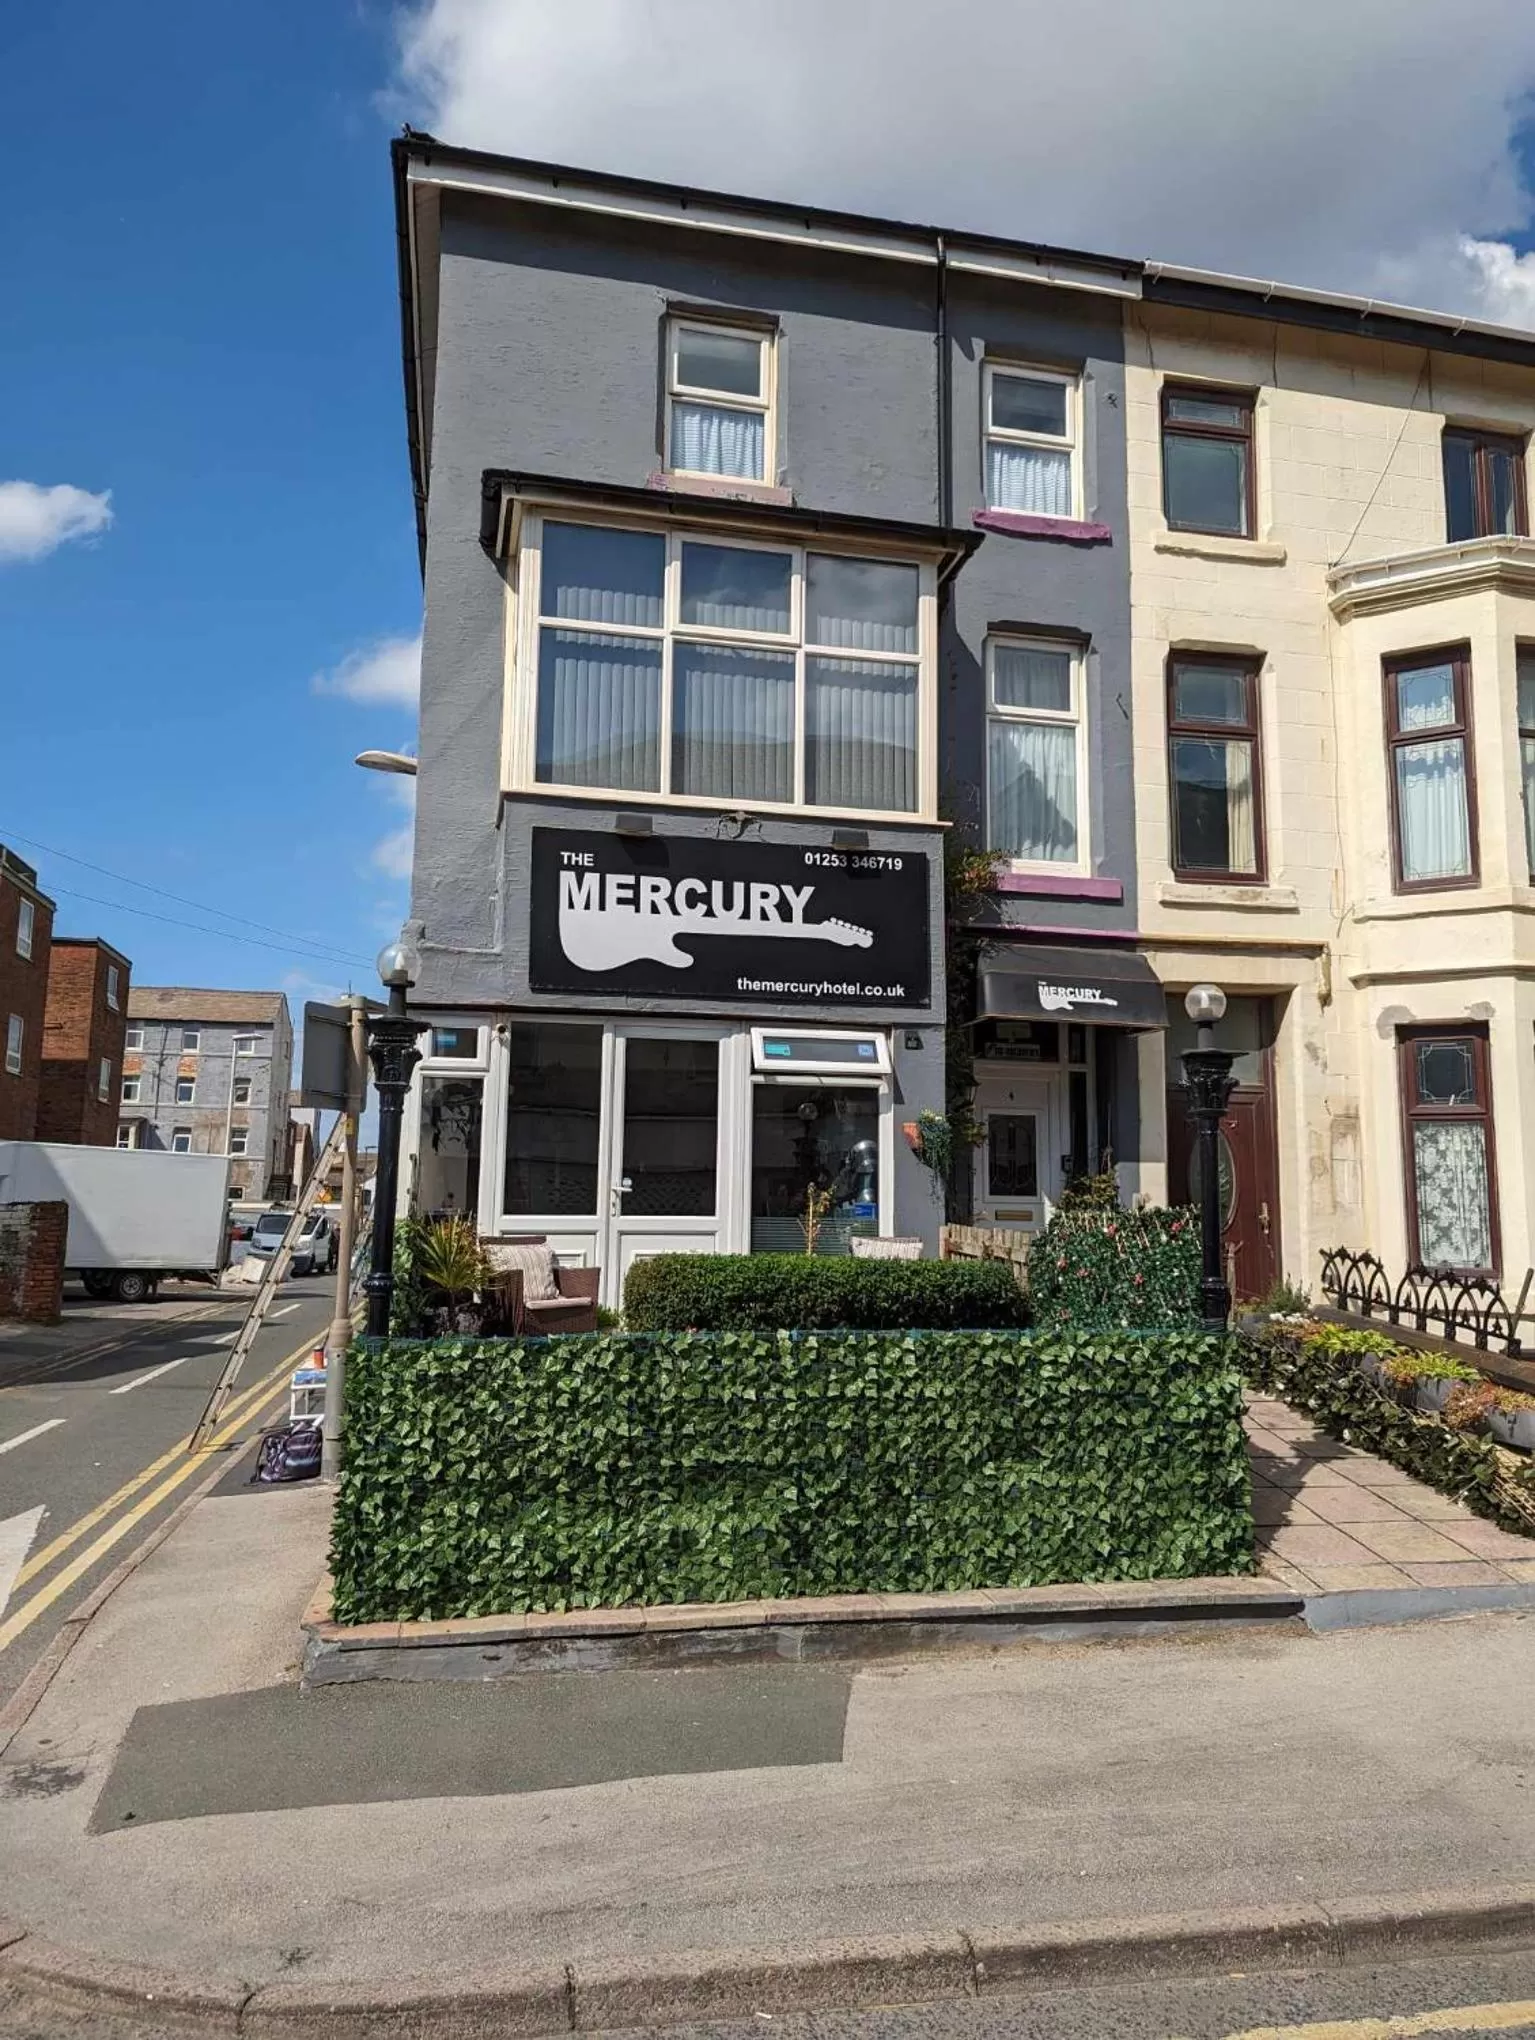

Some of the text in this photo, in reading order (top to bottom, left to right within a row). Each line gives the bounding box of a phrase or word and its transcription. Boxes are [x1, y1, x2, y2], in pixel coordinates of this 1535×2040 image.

[560, 851, 595, 867] THE
[804, 852, 903, 871] 01253 346719
[559, 869, 816, 926] MERCURY
[737, 976, 905, 998] themercuryhotel.co.uk
[1038, 985, 1102, 1001] MERCURY
